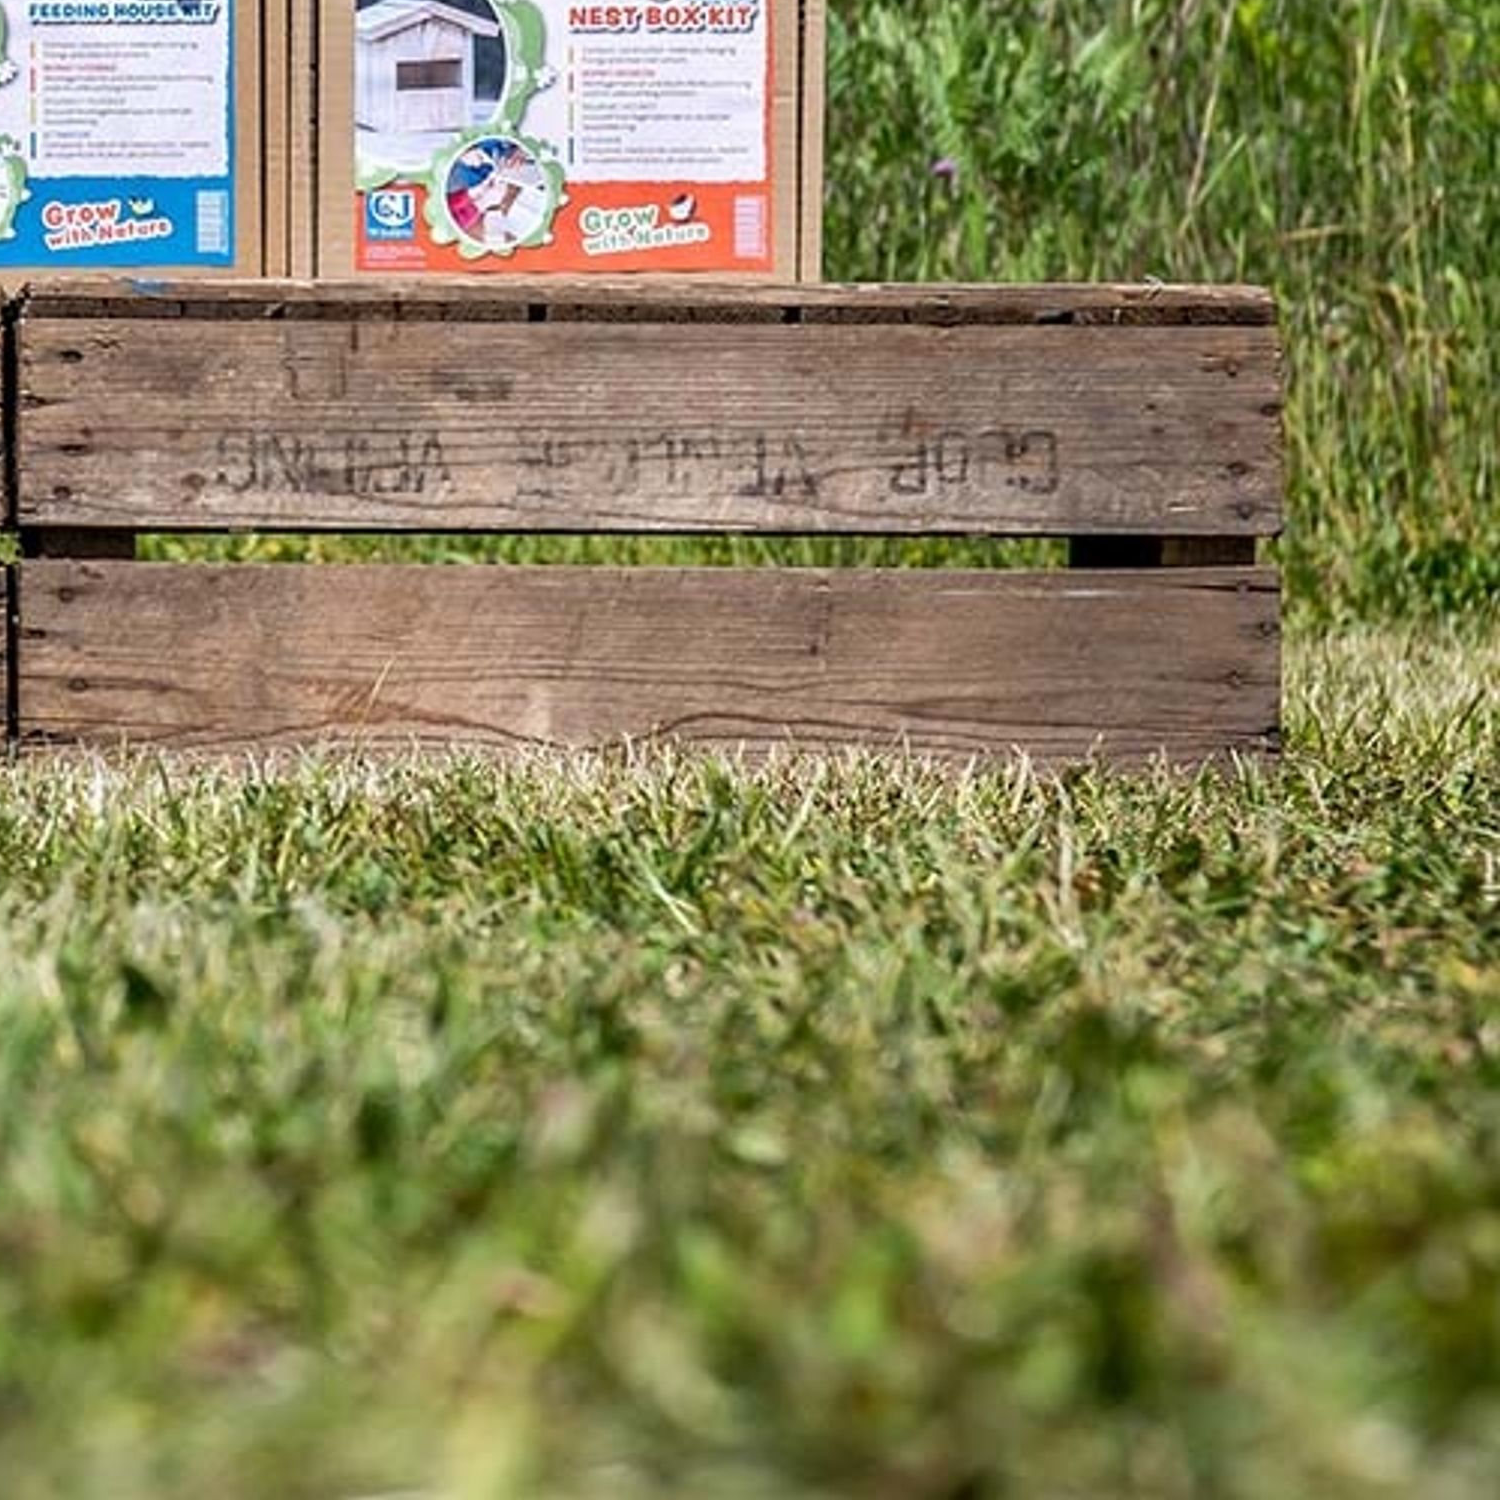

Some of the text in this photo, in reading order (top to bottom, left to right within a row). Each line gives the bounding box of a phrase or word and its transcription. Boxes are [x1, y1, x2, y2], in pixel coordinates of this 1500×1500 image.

[29, 2, 213, 18] FEEDING HOUSE KIT
[569, 5, 752, 27] NEST BOX KIT
[45, 203, 118, 227] Grow
[584, 208, 656, 232] Grow
[49, 220, 168, 246] with Nature
[587, 225, 706, 251] with Nature
